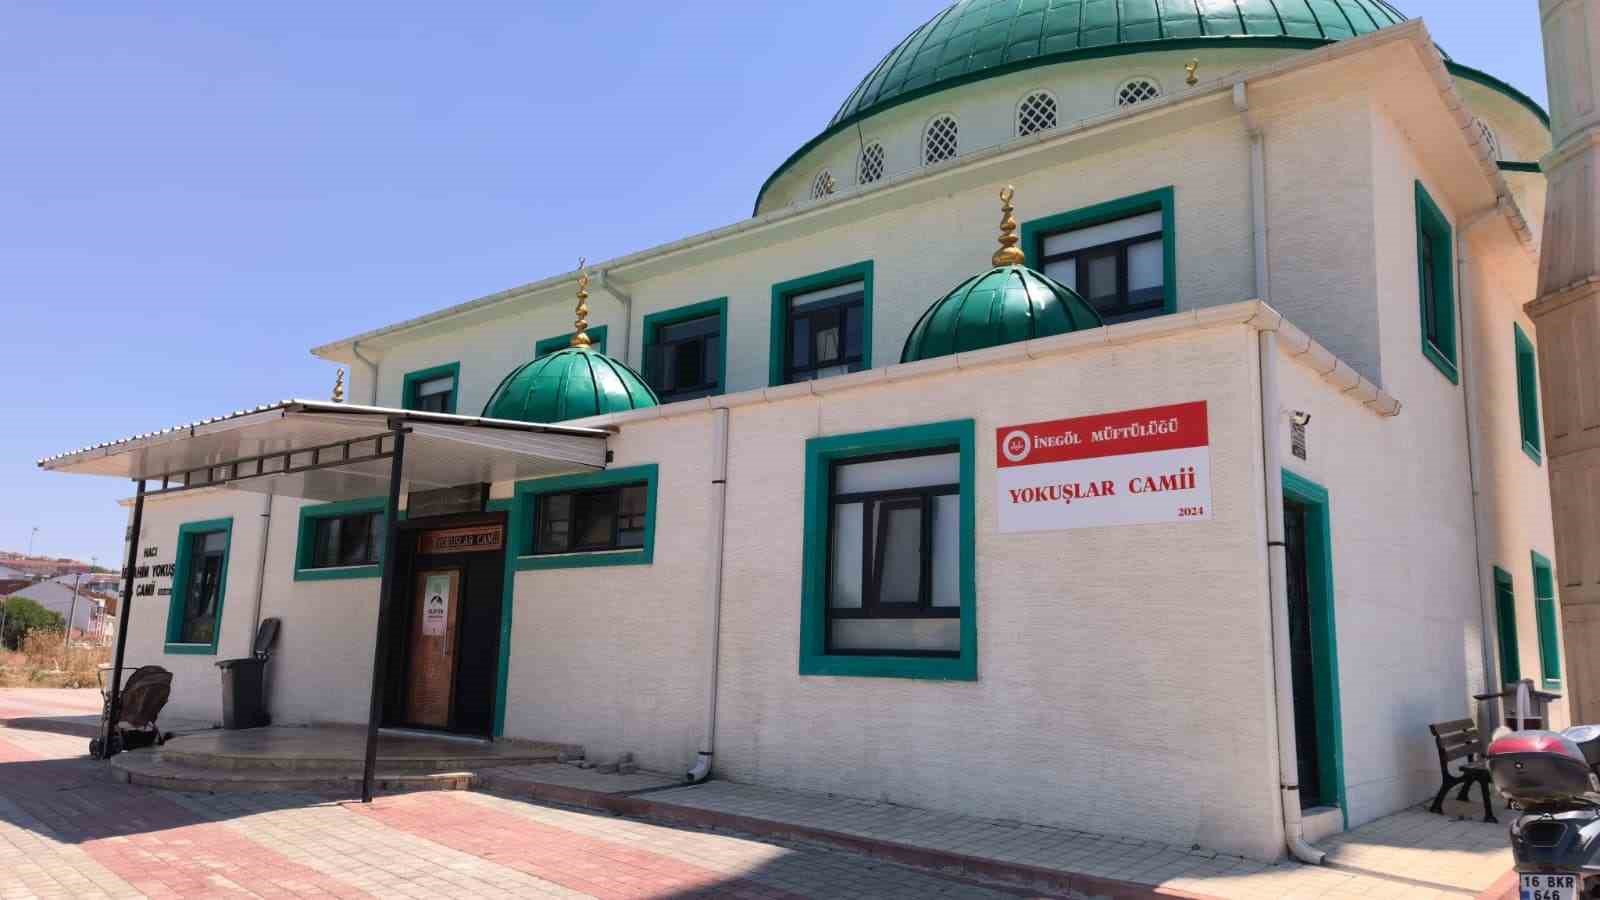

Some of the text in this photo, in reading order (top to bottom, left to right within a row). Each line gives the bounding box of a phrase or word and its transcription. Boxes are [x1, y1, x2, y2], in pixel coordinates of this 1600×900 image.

[1034, 417, 1179, 449] İNEGÖL MÜFTÜLÜĞÜ
[1009, 466, 1196, 504] YOKUŞLAR CAMİİ
[1178, 506, 1204, 517] 2024
[1525, 876, 1574, 888] 16 BKR
[1534, 889, 1561, 900] 646
